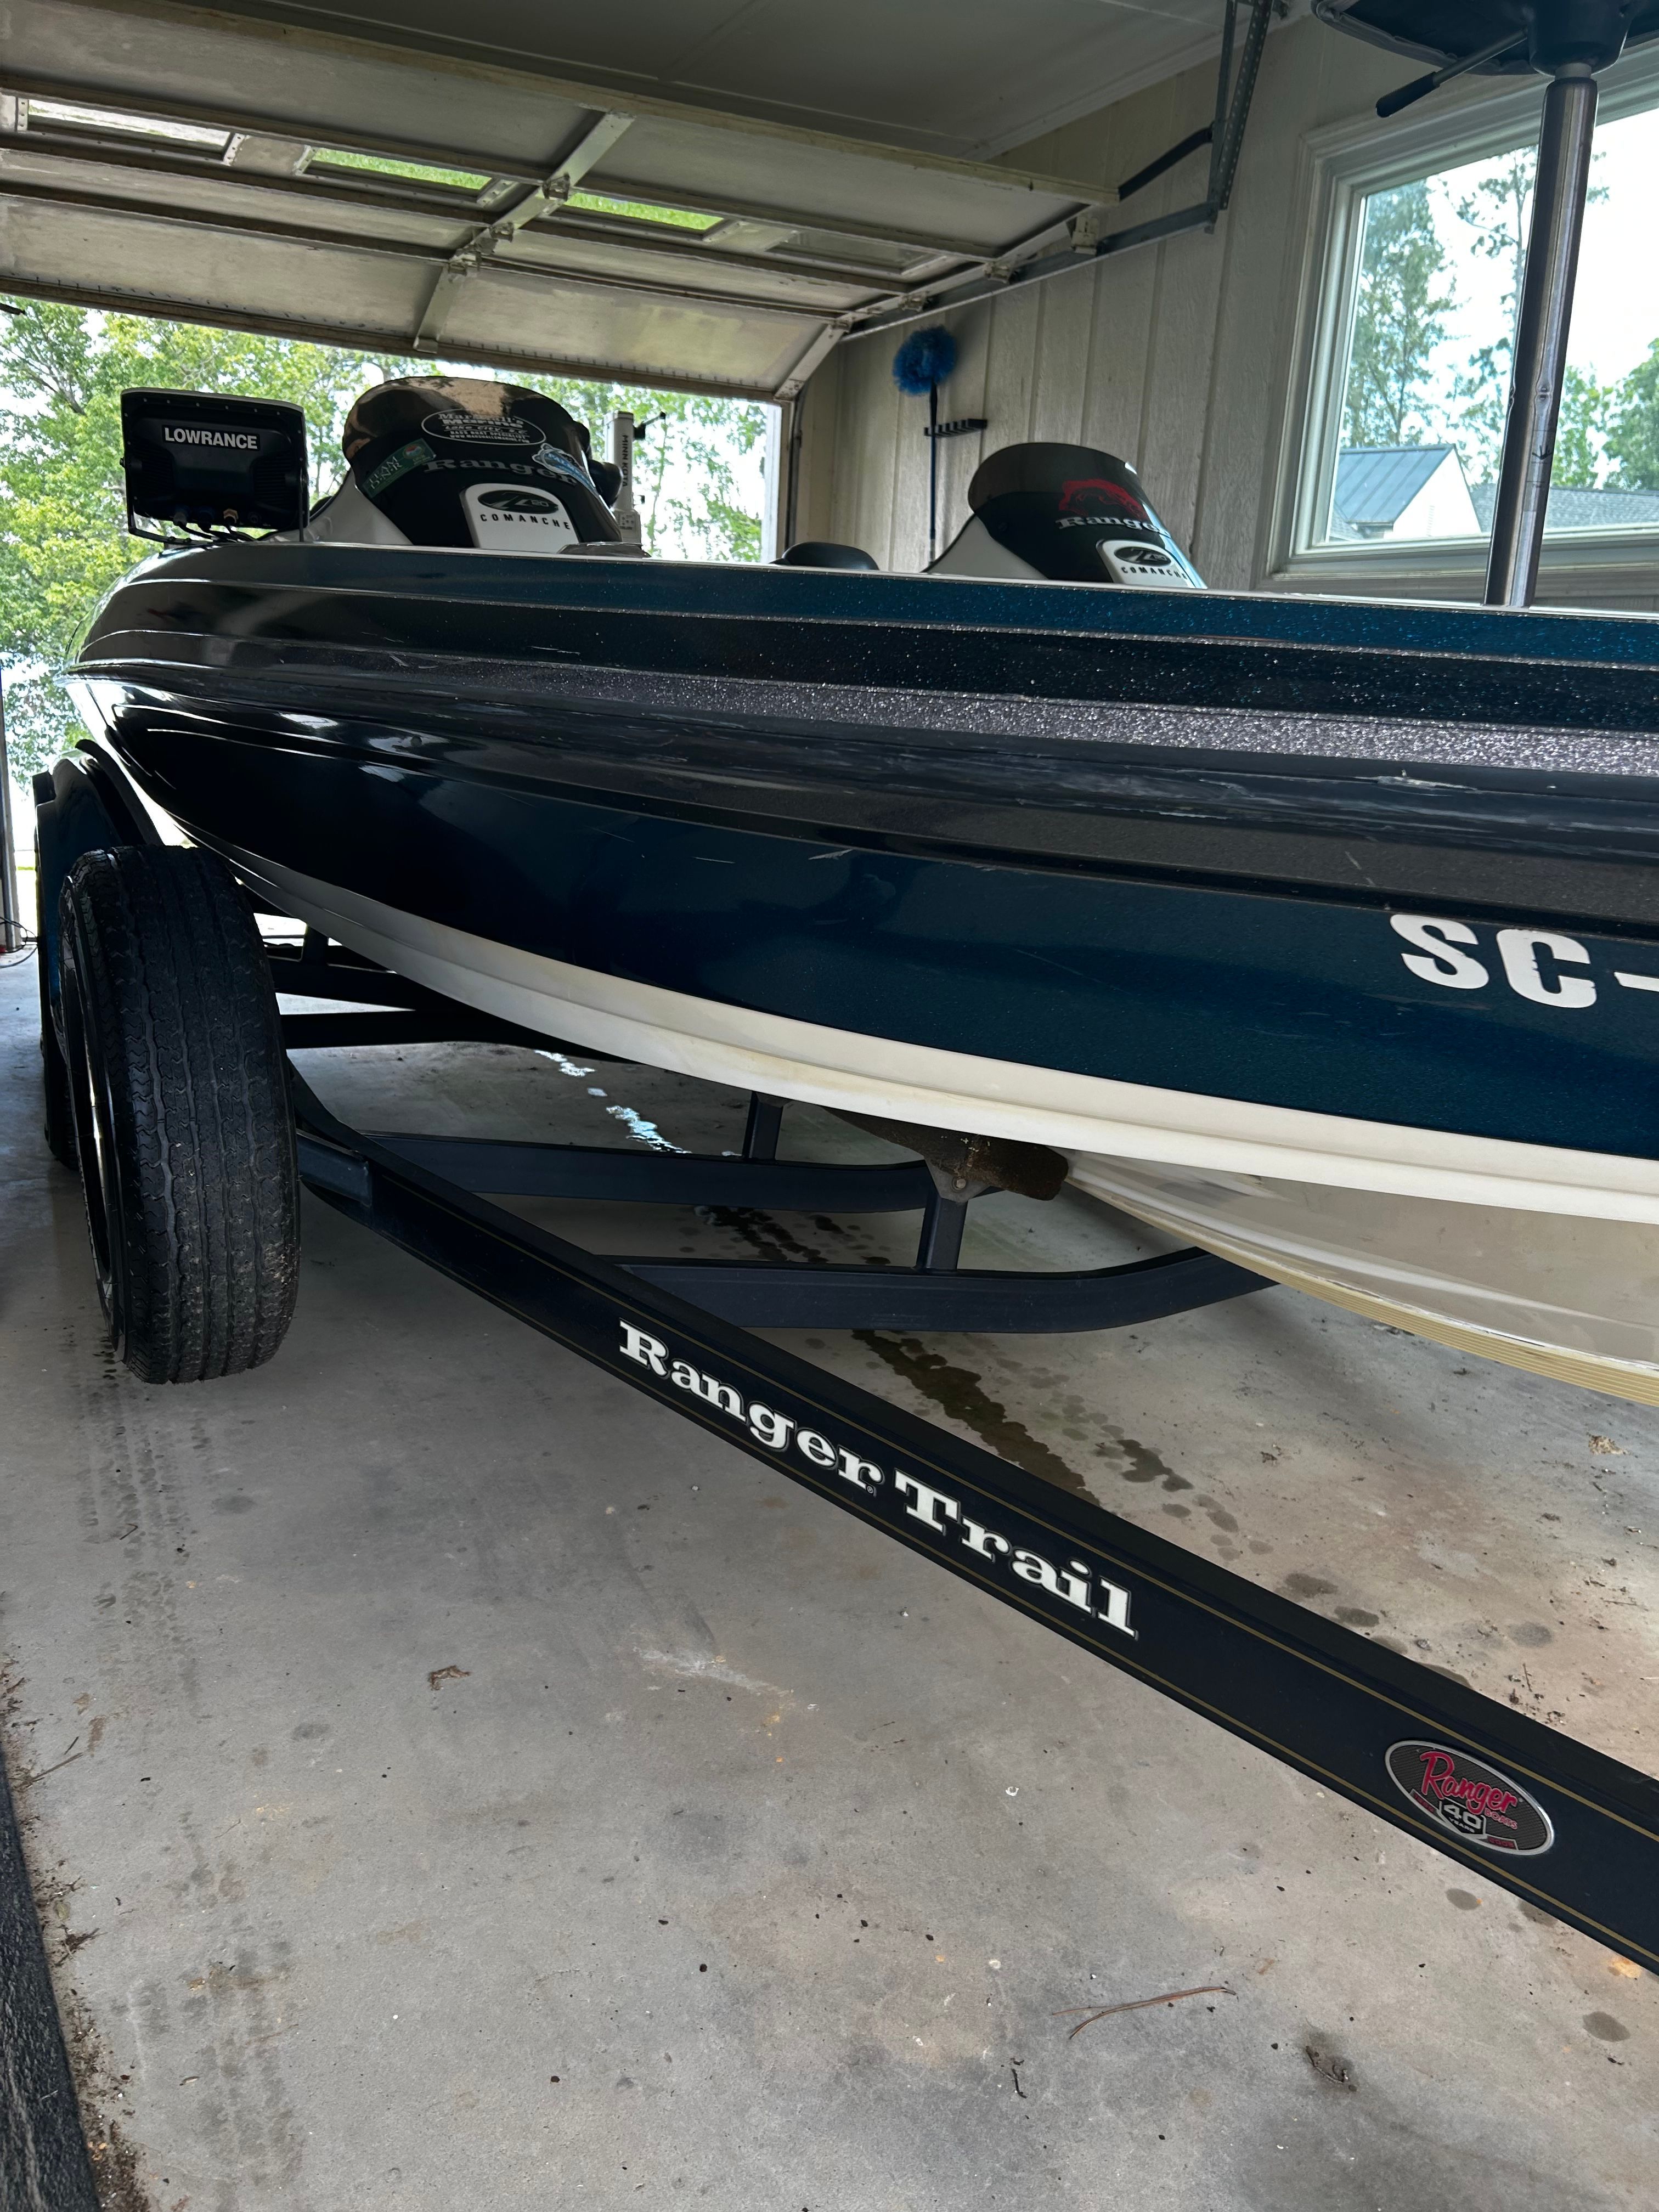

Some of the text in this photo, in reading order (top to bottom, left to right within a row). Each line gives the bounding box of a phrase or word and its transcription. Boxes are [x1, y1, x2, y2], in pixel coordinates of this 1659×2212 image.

[442, 419, 523, 428] Marine
[165, 427, 258, 449] LOWRANCE
[422, 459, 576, 486] Ranger
[480, 514, 571, 530] COMANCHE
[619, 1319, 1137, 1638] Ranger Trail
[1420, 1751, 1517, 1815] Ranger
[1443, 1804, 1481, 1829] 40
